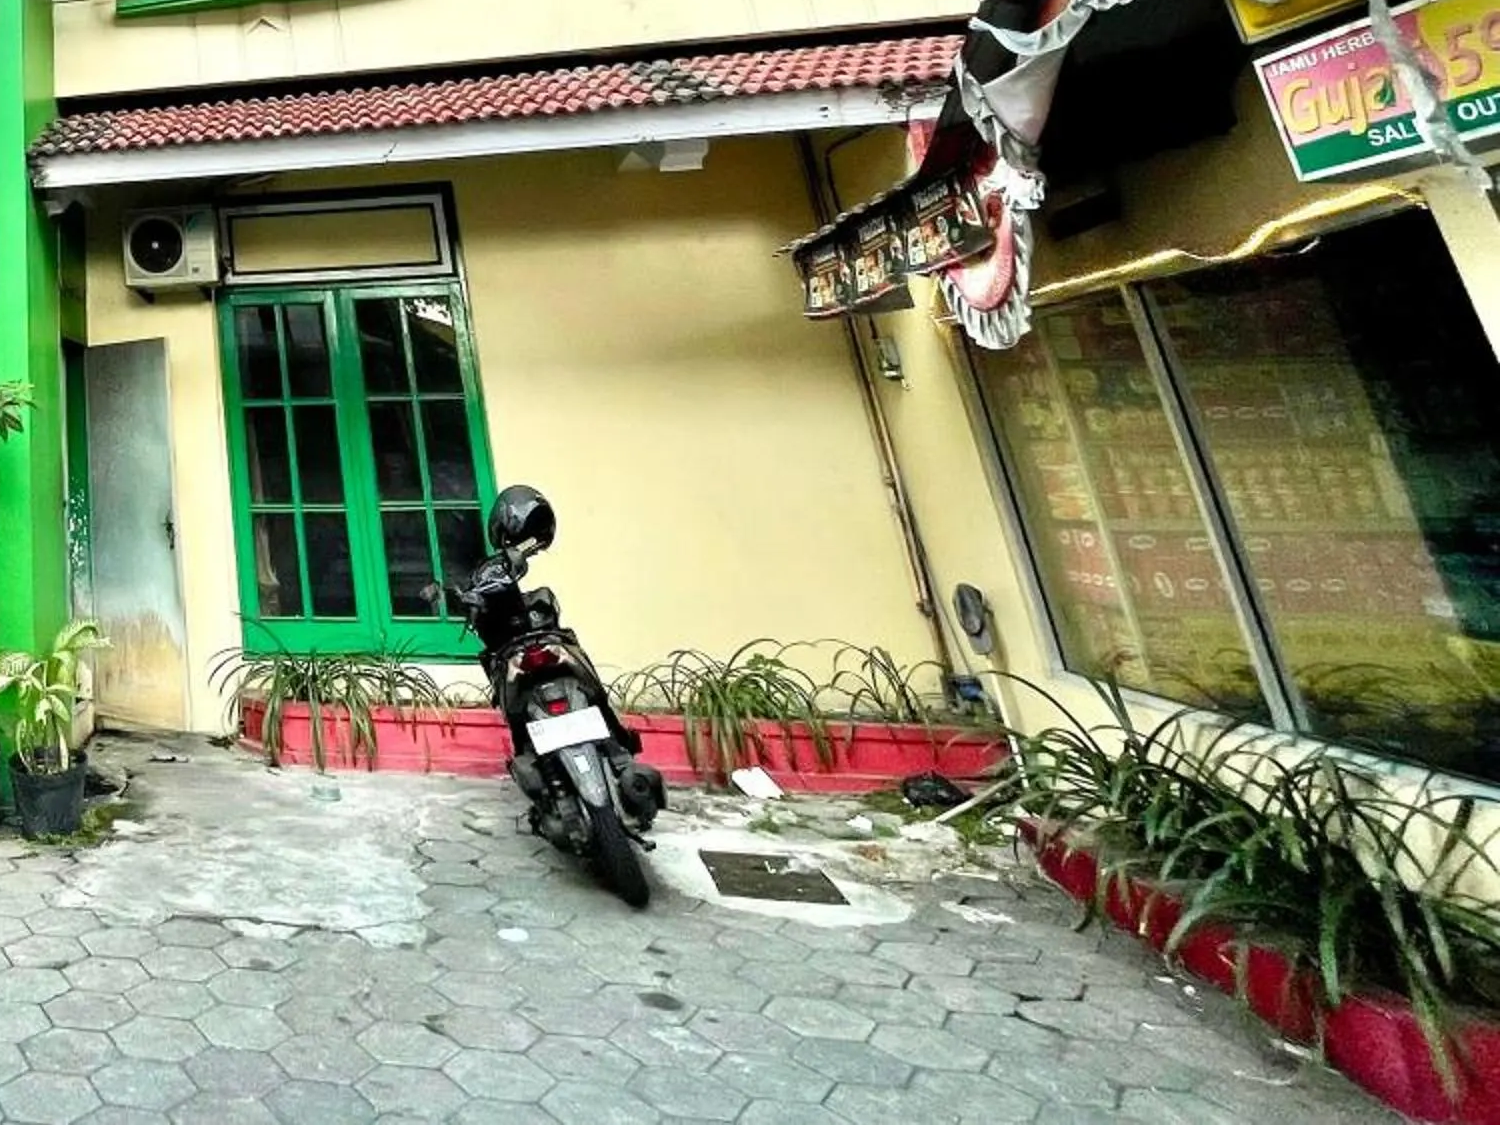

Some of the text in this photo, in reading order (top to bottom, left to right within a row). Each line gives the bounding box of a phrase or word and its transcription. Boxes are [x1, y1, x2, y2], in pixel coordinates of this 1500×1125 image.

[1268, 31, 1377, 78] JAMU HERB
[1281, 61, 1397, 135] Guja
